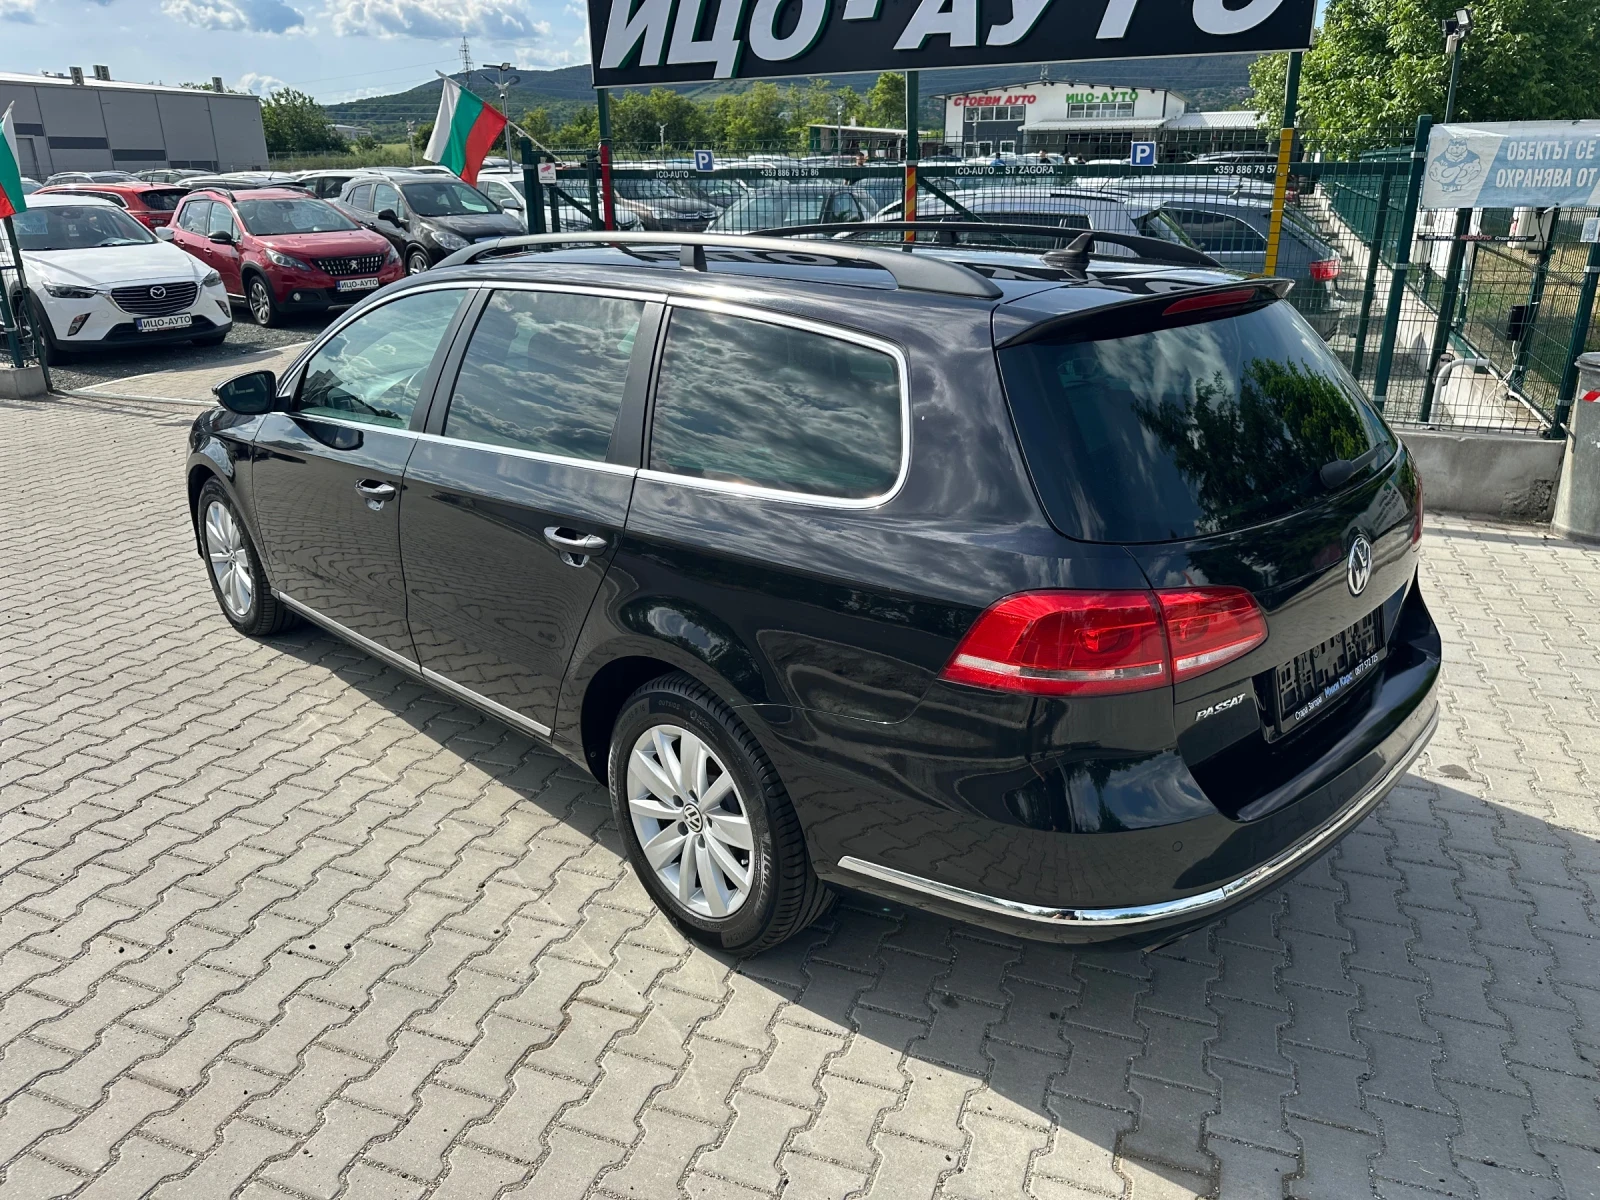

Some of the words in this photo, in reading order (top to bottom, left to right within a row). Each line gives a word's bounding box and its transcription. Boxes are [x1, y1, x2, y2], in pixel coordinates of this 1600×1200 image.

[953, 96, 1002, 106] СТОЕВИ
[1004, 95, 1036, 105] АУТО
[1066, 91, 1139, 103] ИЦО-АУТО
[1135, 145, 1150, 163] P
[1506, 140, 1573, 161] ОБЕКТЪТ
[1575, 139, 1597, 160] СЕ
[697, 153, 709, 169] P
[778, 169, 790, 177] 886
[1018, 166, 1054, 175] ZAGORA
[1213, 165, 1233, 174] +359
[1236, 165, 1251, 174] 886
[1254, 165, 1264, 174] 79
[1495, 168, 1571, 188] ОХРАНЯВА
[1576, 167, 1598, 187] ОТ
[340, 279, 378, 289] ИЦО-АУТО
[143, 315, 190, 328] ИЦО-АУТО
[1195, 693, 1246, 721] PASSAT
